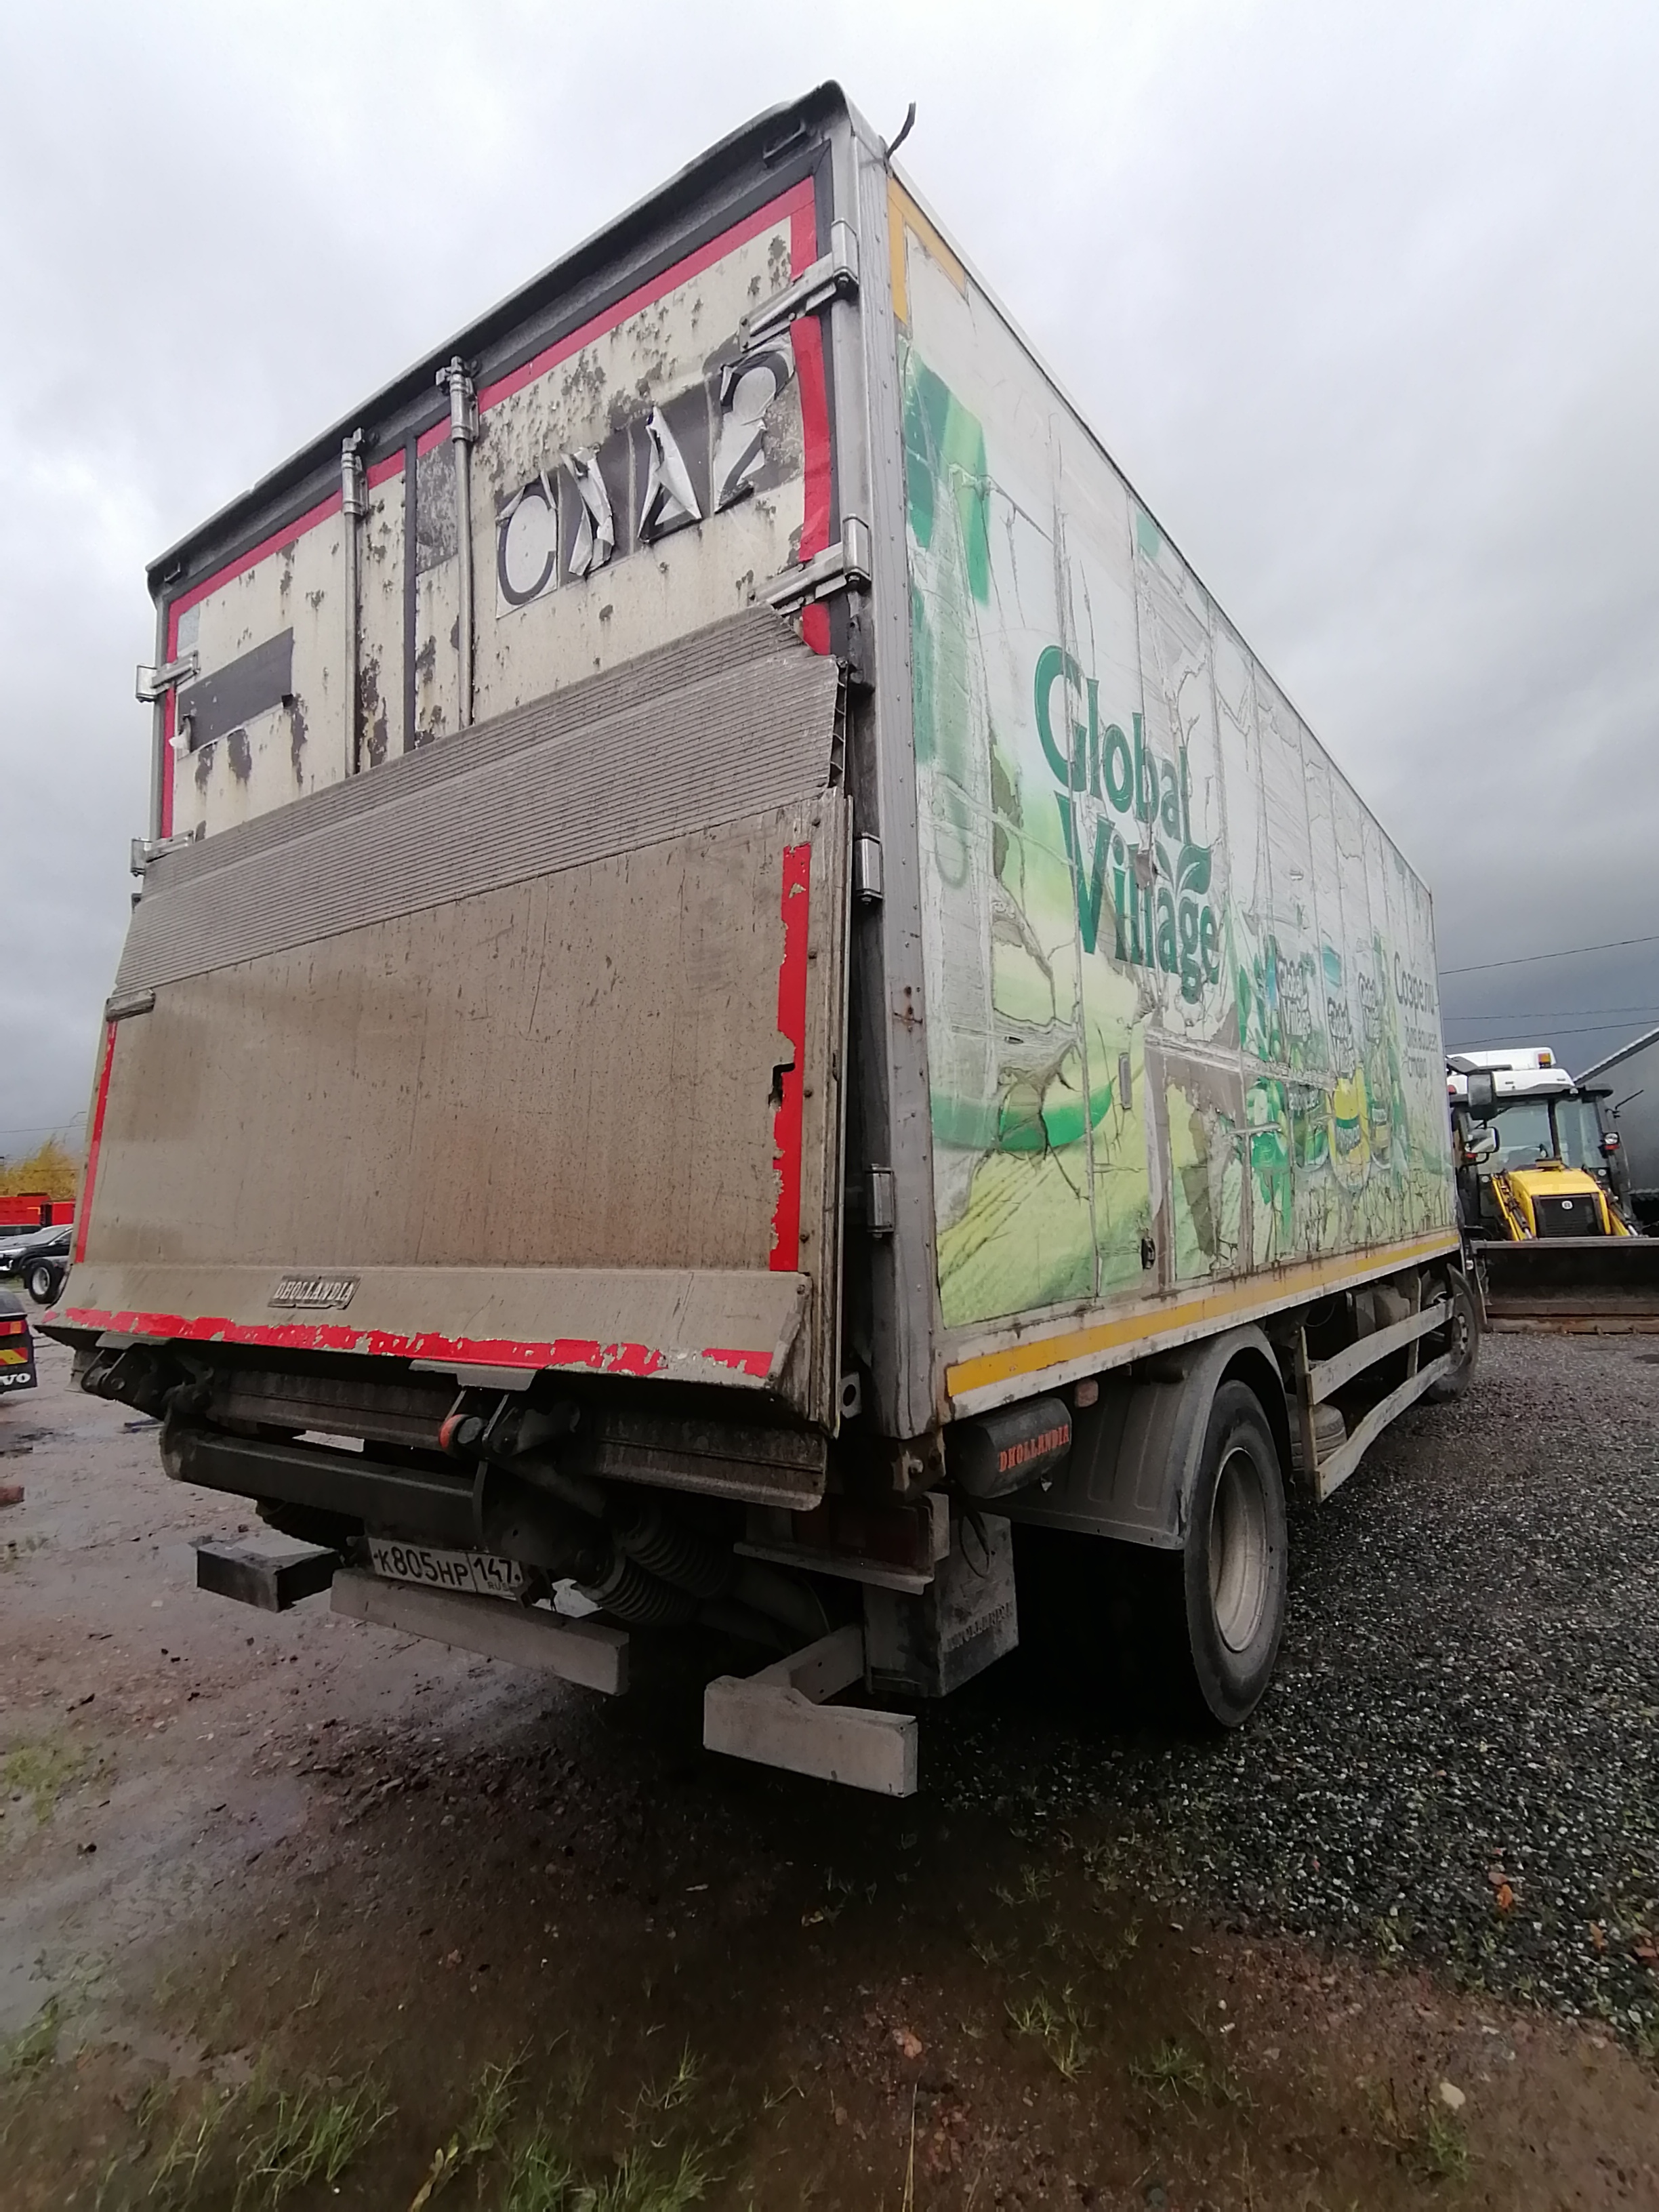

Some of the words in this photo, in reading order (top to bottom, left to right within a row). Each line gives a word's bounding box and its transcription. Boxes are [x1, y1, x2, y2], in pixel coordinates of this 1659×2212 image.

[1034, 645, 1194, 845] Global
[1054, 790, 1219, 1004] Village
[273, 1281, 354, 1300] DHOLLANDIA
[998, 1424, 1070, 1473] DHOLLANDIA
